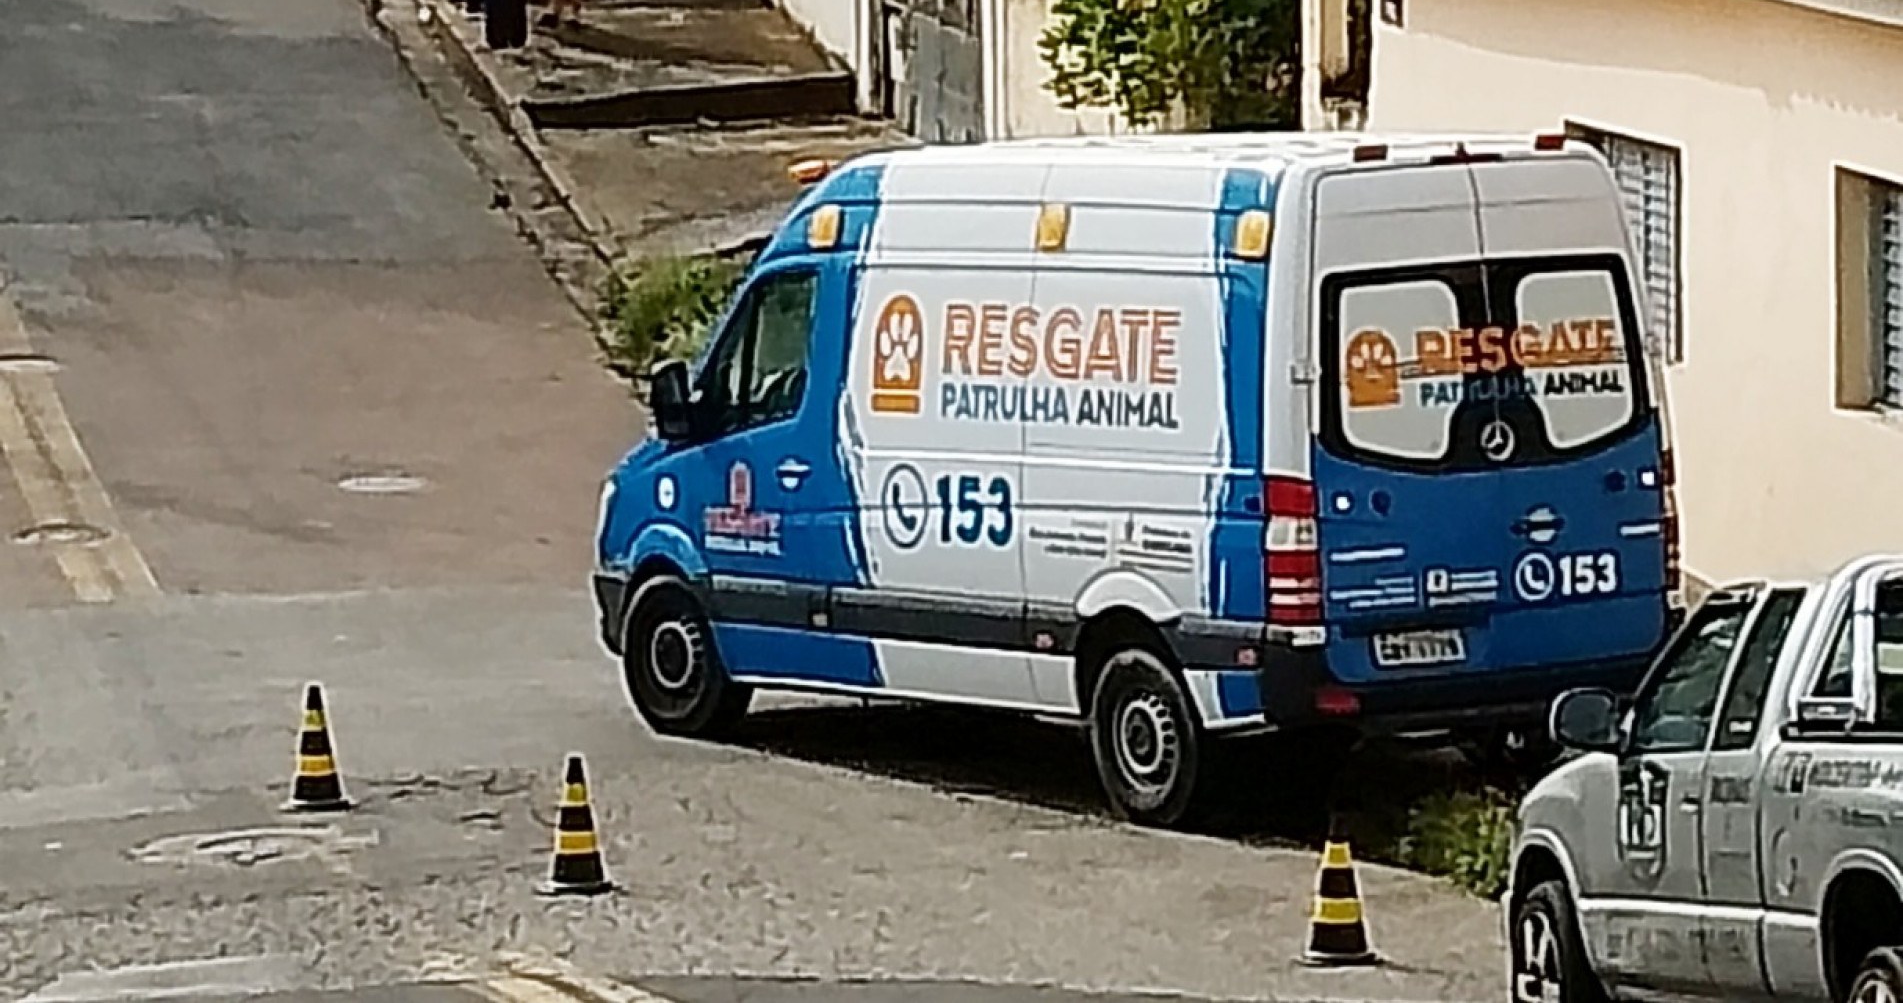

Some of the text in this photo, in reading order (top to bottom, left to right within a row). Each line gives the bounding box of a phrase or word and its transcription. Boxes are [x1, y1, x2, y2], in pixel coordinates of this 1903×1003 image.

[942, 303, 1181, 385] RESGATE
[1415, 319, 1617, 375] RESGATE
[941, 382, 1179, 429] PATRULHA ANIMAL
[1544, 369, 1624, 396] ANIMAL
[936, 474, 1013, 547] 153
[1558, 552, 1617, 597] 153
